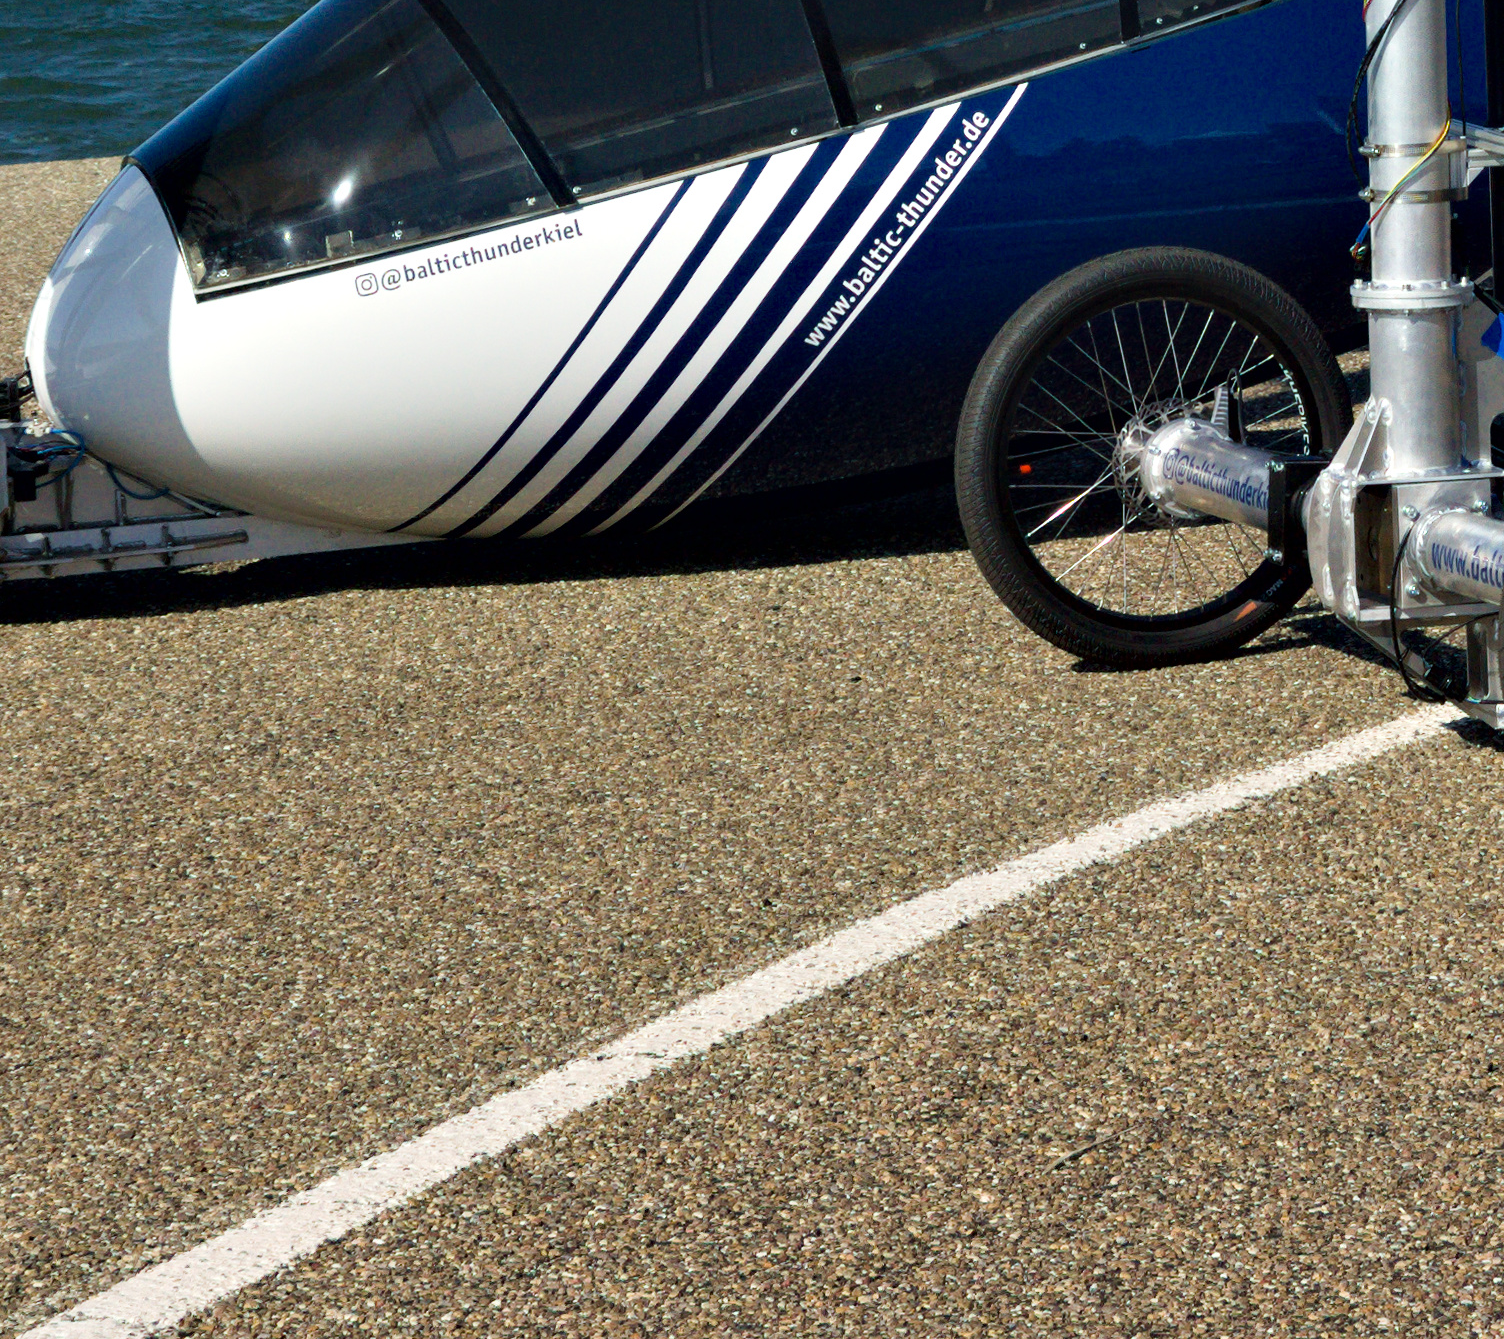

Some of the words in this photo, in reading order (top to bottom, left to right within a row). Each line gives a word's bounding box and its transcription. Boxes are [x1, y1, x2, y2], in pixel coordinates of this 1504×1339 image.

[381, 219, 583, 290] @balticthunderkiel
[804, 110, 990, 347] www.baltic-thunder.de
[1176, 454, 1269, 511] @balticthunderki
